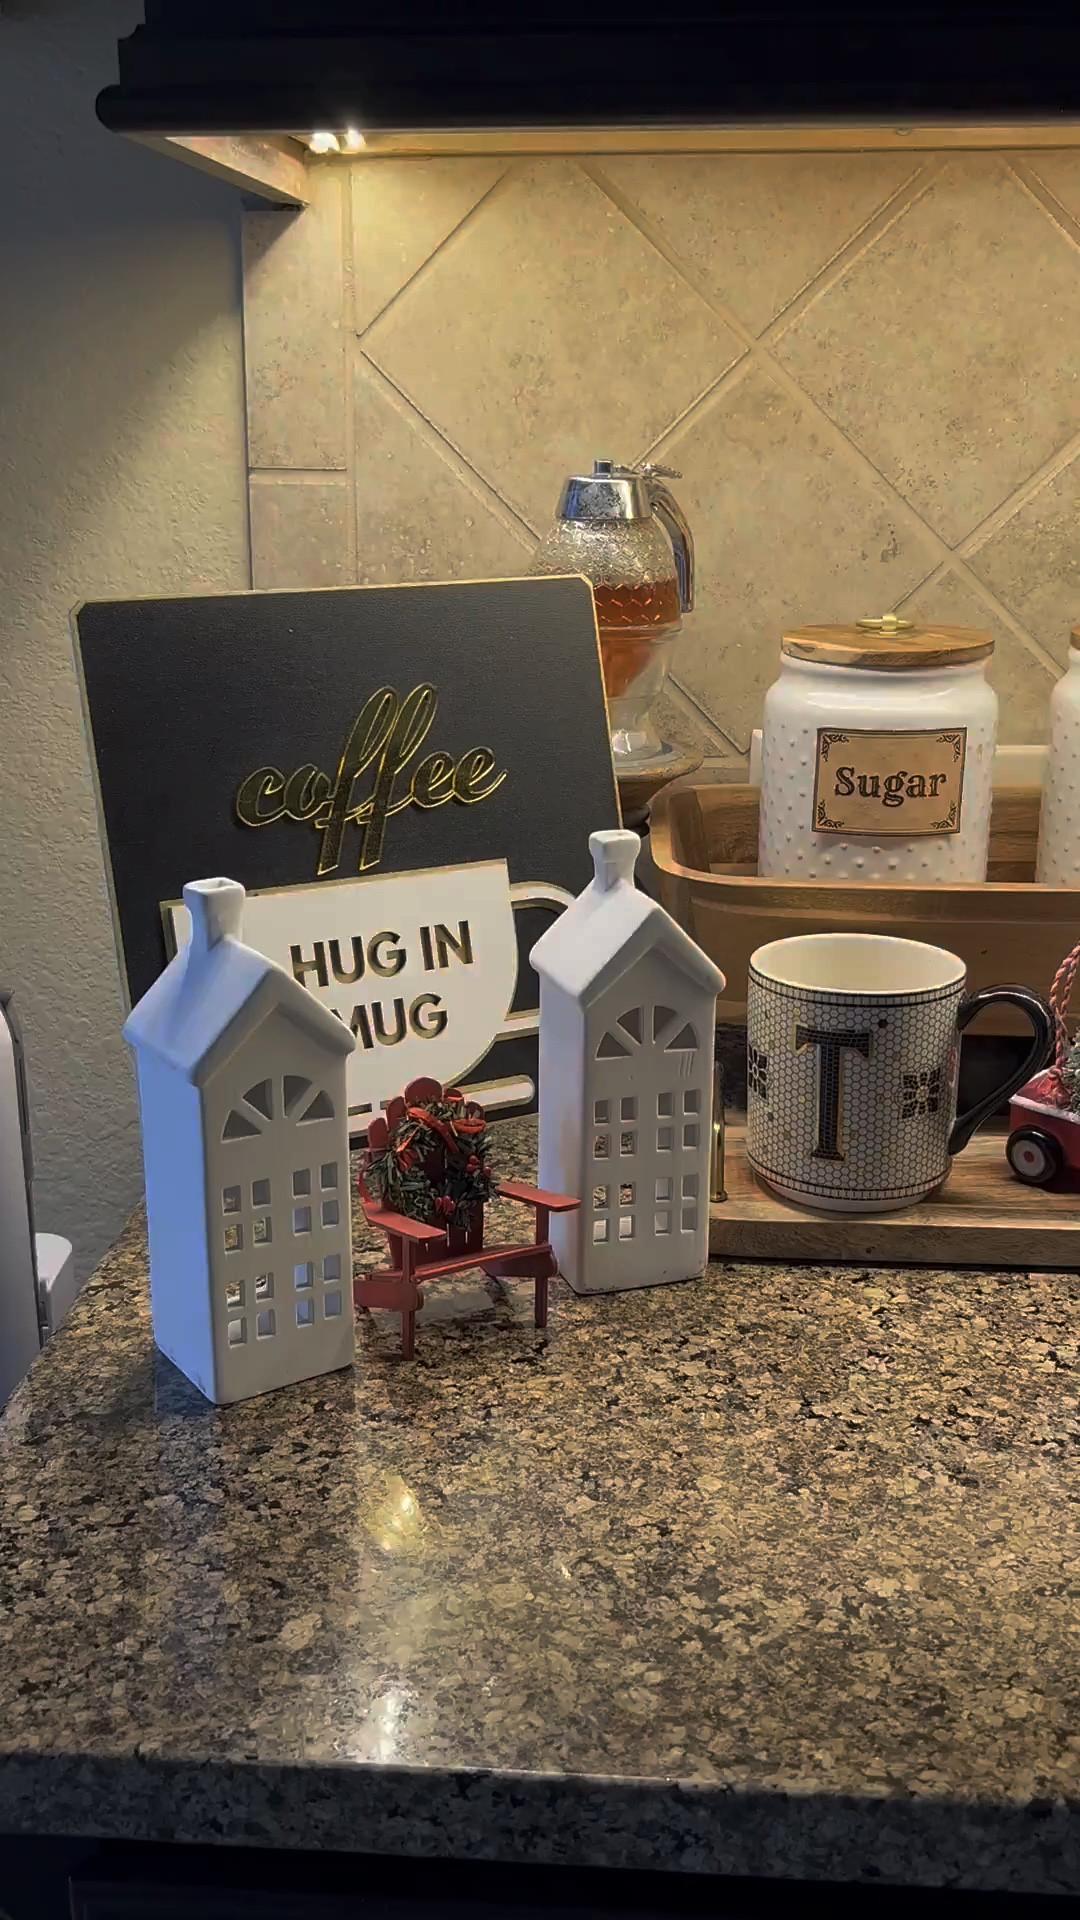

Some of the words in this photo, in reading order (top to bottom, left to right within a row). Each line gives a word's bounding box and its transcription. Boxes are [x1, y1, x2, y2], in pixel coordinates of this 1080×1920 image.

[236, 682, 508, 876] coffee
[833, 766, 947, 808] Sugar
[289, 931, 407, 987] HUG
[419, 920, 474, 971] IN
[794, 1024, 873, 1163] T
